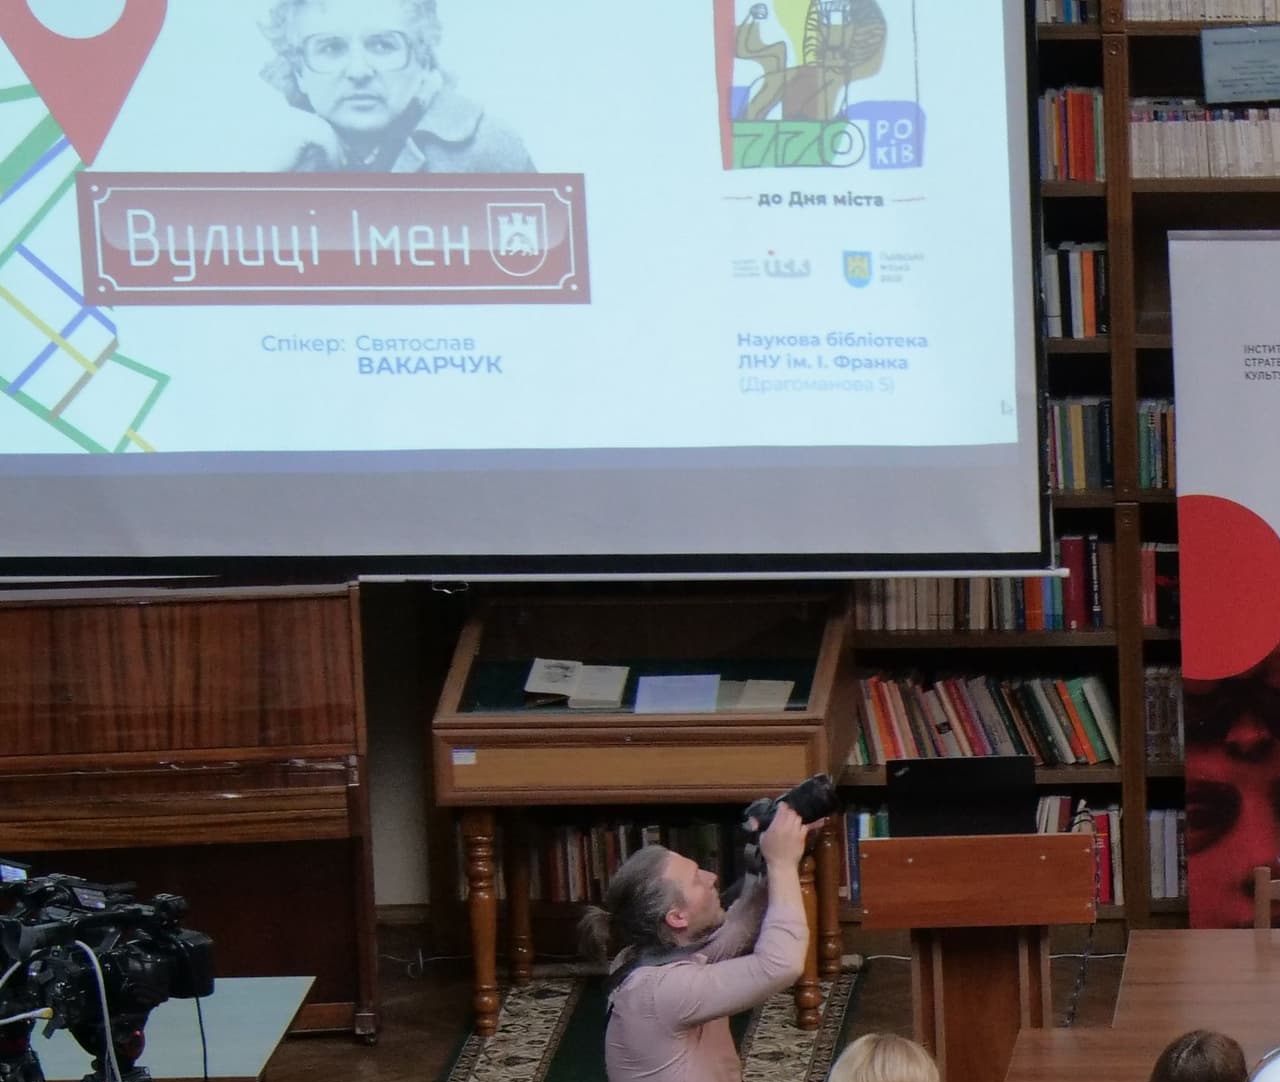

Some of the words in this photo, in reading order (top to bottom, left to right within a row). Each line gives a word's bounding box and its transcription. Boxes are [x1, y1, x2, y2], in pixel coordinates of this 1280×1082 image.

[757, 193, 783, 207] до
[788, 191, 827, 207] Дня
[833, 190, 885, 207] міста
[127, 208, 319, 282] Вулиці
[352, 209, 471, 268] Імен
[261, 334, 346, 355] Спікер:
[355, 335, 476, 352] Святослав
[737, 333, 821, 350] Наукова
[826, 331, 930, 349] бібліотека
[357, 355, 503, 375] ВАКАРЧУК
[738, 355, 781, 369] ЛНУ
[786, 353, 812, 369] ім.
[834, 354, 909, 371] Франка
